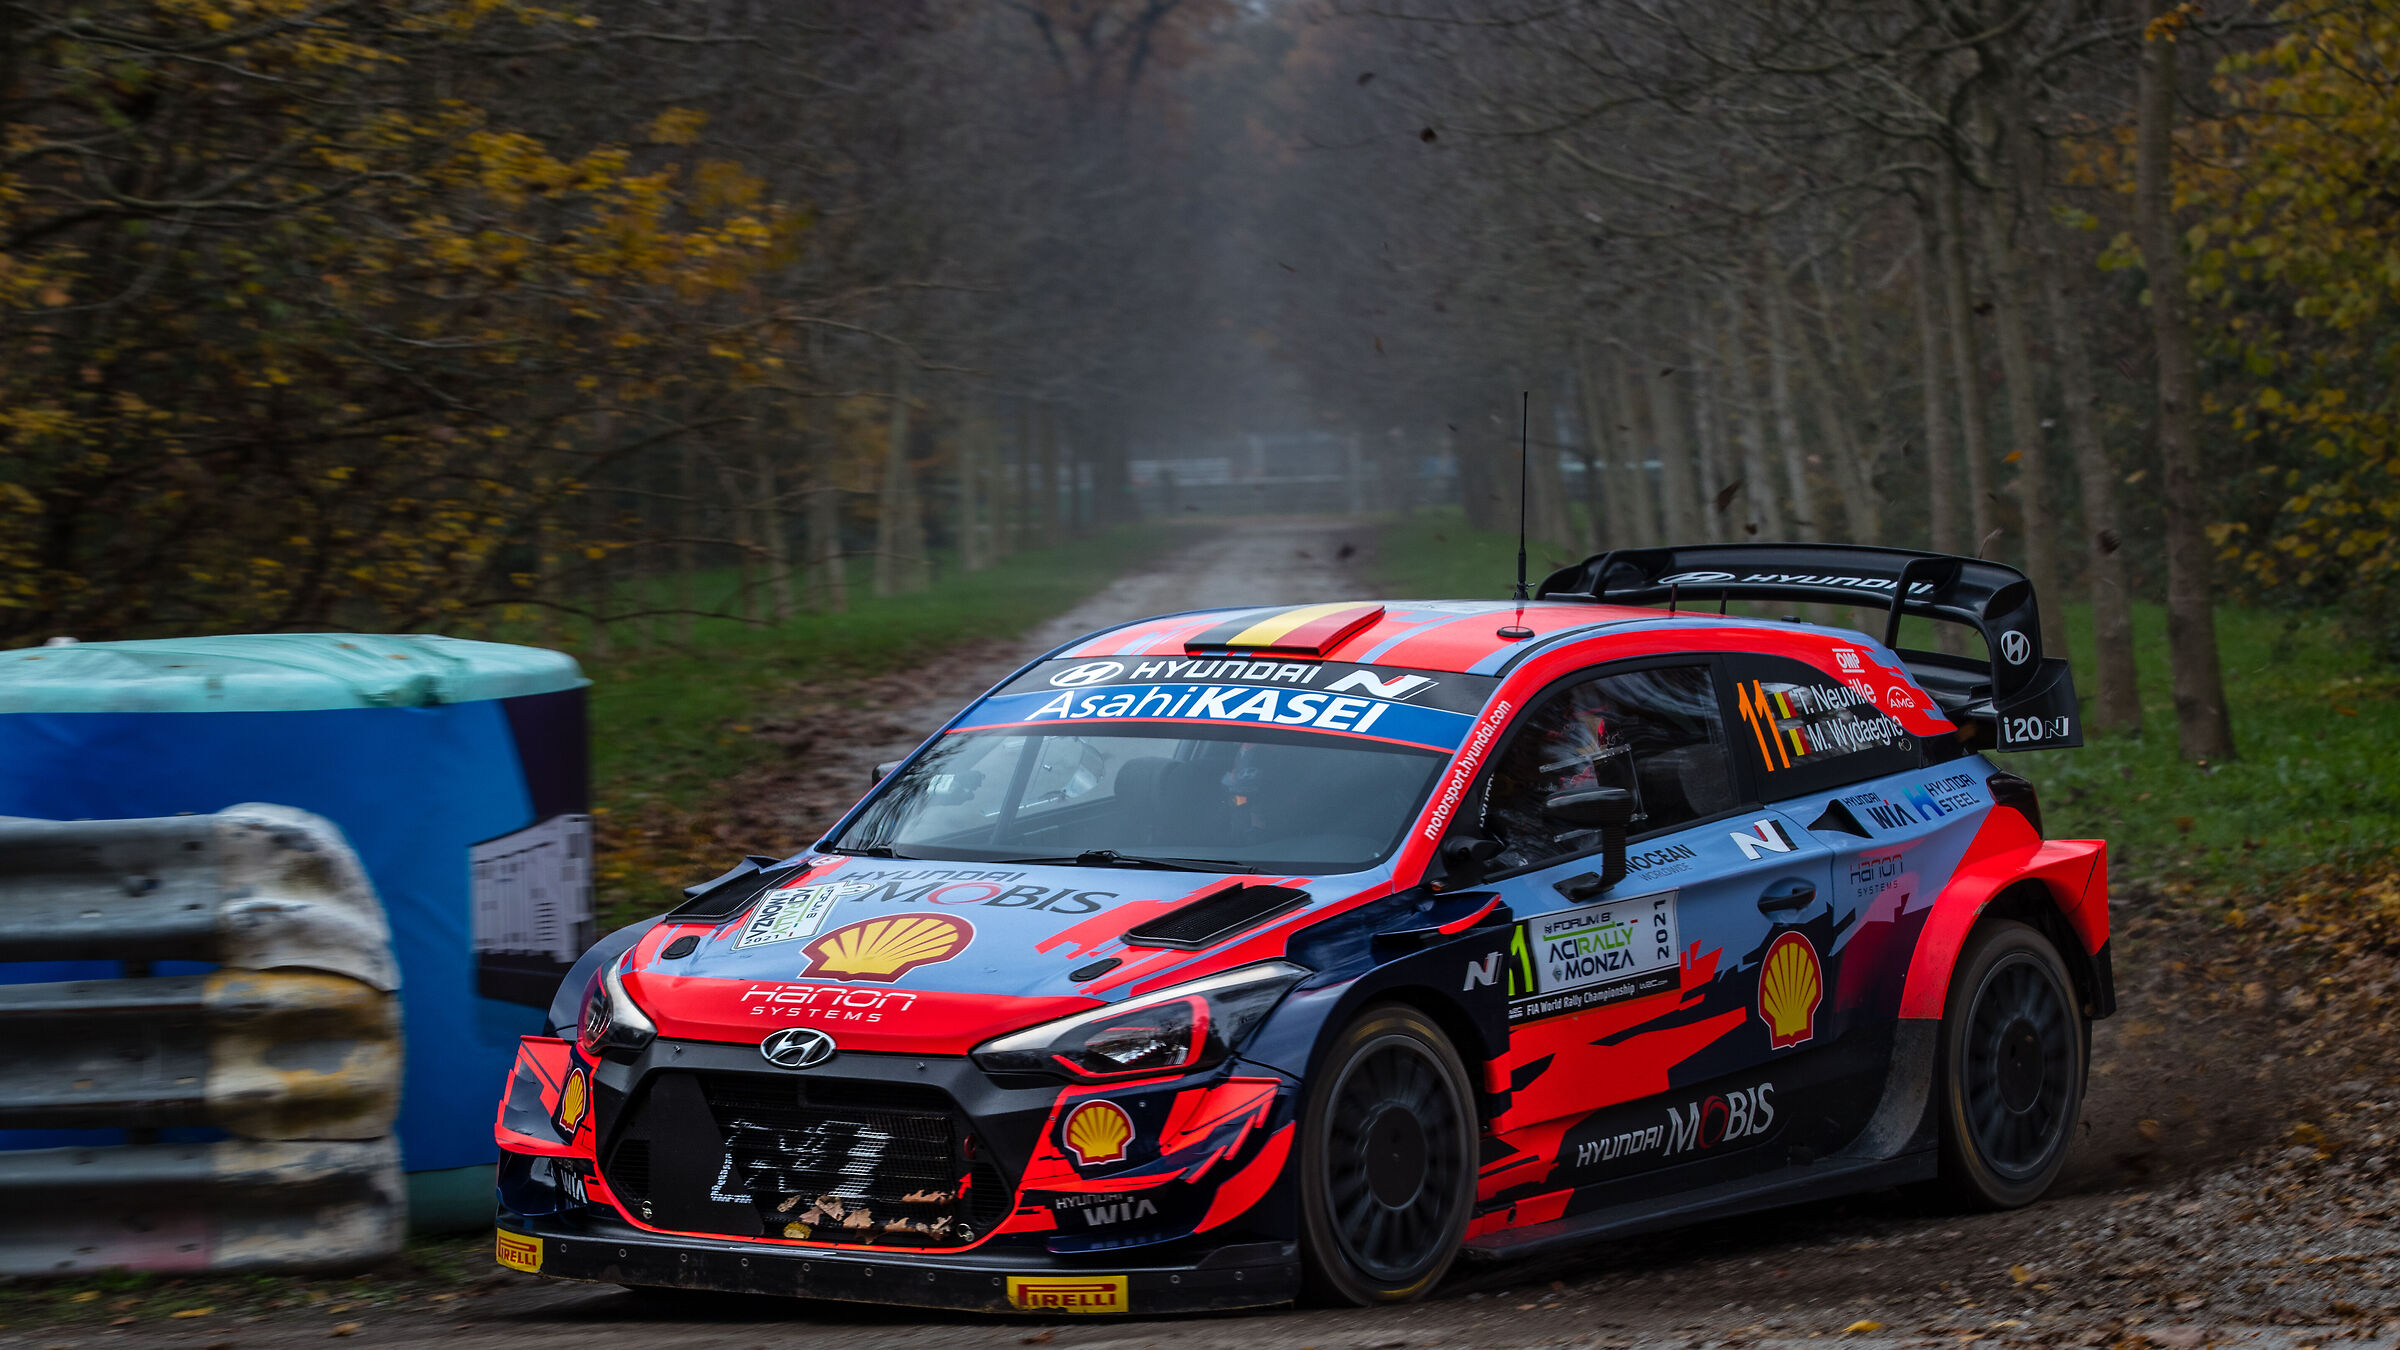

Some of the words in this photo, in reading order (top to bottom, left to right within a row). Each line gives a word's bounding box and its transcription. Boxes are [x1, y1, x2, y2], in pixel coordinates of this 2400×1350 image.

[1129, 660, 1322, 685] HYUNDAI
[1835, 651, 1861, 670] OMP
[1793, 688, 1814, 715] T.
[1810, 678, 1877, 712] Neuville
[1024, 686, 1390, 733] AsahiKASEI
[1737, 680, 1791, 772] 11
[1806, 722, 1832, 752] M.
[1827, 713, 1904, 752] Wydaeghe
[1424, 700, 1512, 840] motorsport.hyundai.com
[1924, 773, 1977, 798] HYUNDAI
[1841, 792, 1881, 808] HYUNDAI
[1938, 792, 1980, 813] STEEL
[837, 869, 1027, 883] HYUNDAI
[1639, 862, 1693, 881] WORLDWIDE
[851, 881, 1121, 914] MOBIS
[1857, 880, 1899, 897] SYSTEMS
[745, 934, 780, 945] 2021
[1653, 899, 1670, 960] 2021
[1565, 949, 1635, 981] MONZA
[1526, 1002, 1540, 1016] FIA
[1541, 998, 1563, 1012] World
[1563, 995, 1583, 1008] Rally
[1583, 984, 1636, 1004] Championship
[750, 1005, 883, 1023] SYSTEMS
[1576, 1124, 1666, 1168] HYUNDAI
[1662, 1082, 1775, 1158] MOBIS
[1055, 1193, 1123, 1210] HYUNDAI
[498, 1235, 538, 1267] PIRELLI
[1016, 1283, 1118, 1308] PIRELLI
